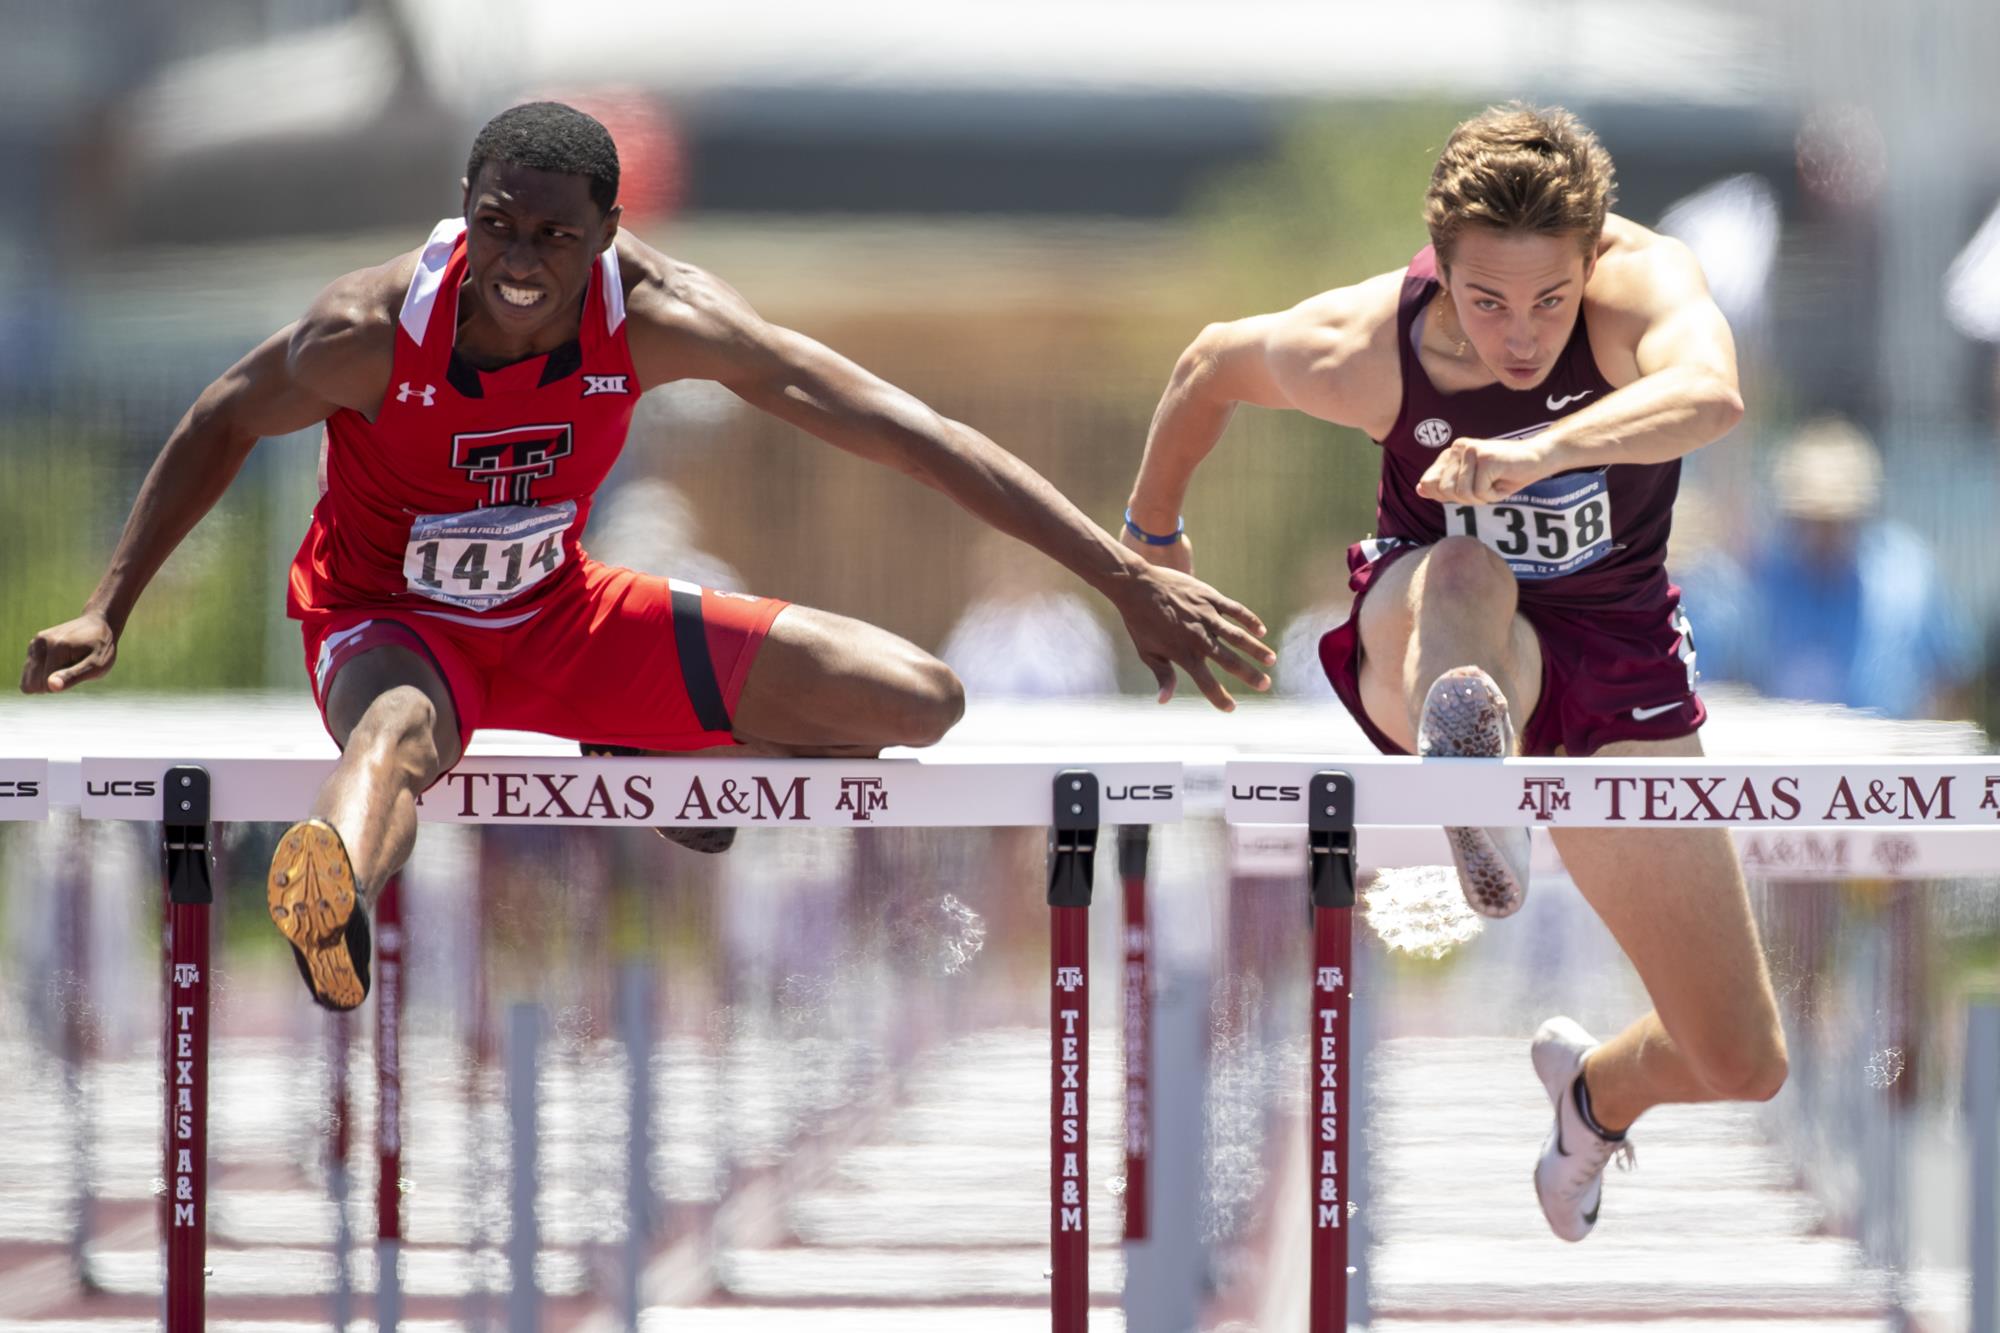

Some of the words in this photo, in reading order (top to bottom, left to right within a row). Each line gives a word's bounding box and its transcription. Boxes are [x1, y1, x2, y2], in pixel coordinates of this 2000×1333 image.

[1417, 420, 1450, 446] SEC
[1531, 481, 1599, 506] CHAMPIONSHIPS
[478, 526, 502, 535] FIELD
[503, 512, 570, 534] CHAMPIONSHIPS
[1456, 500, 1604, 560] 1358
[415, 530, 563, 591] 1414
[0, 781, 39, 797] CS
[87, 780, 155, 797] UCS
[447, 773, 656, 820] TEXAS
[675, 775, 811, 820] A&M
[1106, 784, 1175, 801] UCS
[1232, 784, 1301, 801] UCS
[1595, 776, 1802, 821] TEXAS
[1822, 775, 1957, 820] A&M
[176, 1006, 194, 1140] TEXAS
[1060, 1009, 1080, 1144] TEXAS
[1319, 1008, 1339, 1142] TEXAS
[174, 1149, 195, 1227] A&M
[1061, 1153, 1082, 1231] A&M
[1318, 1151, 1340, 1228] A&M
